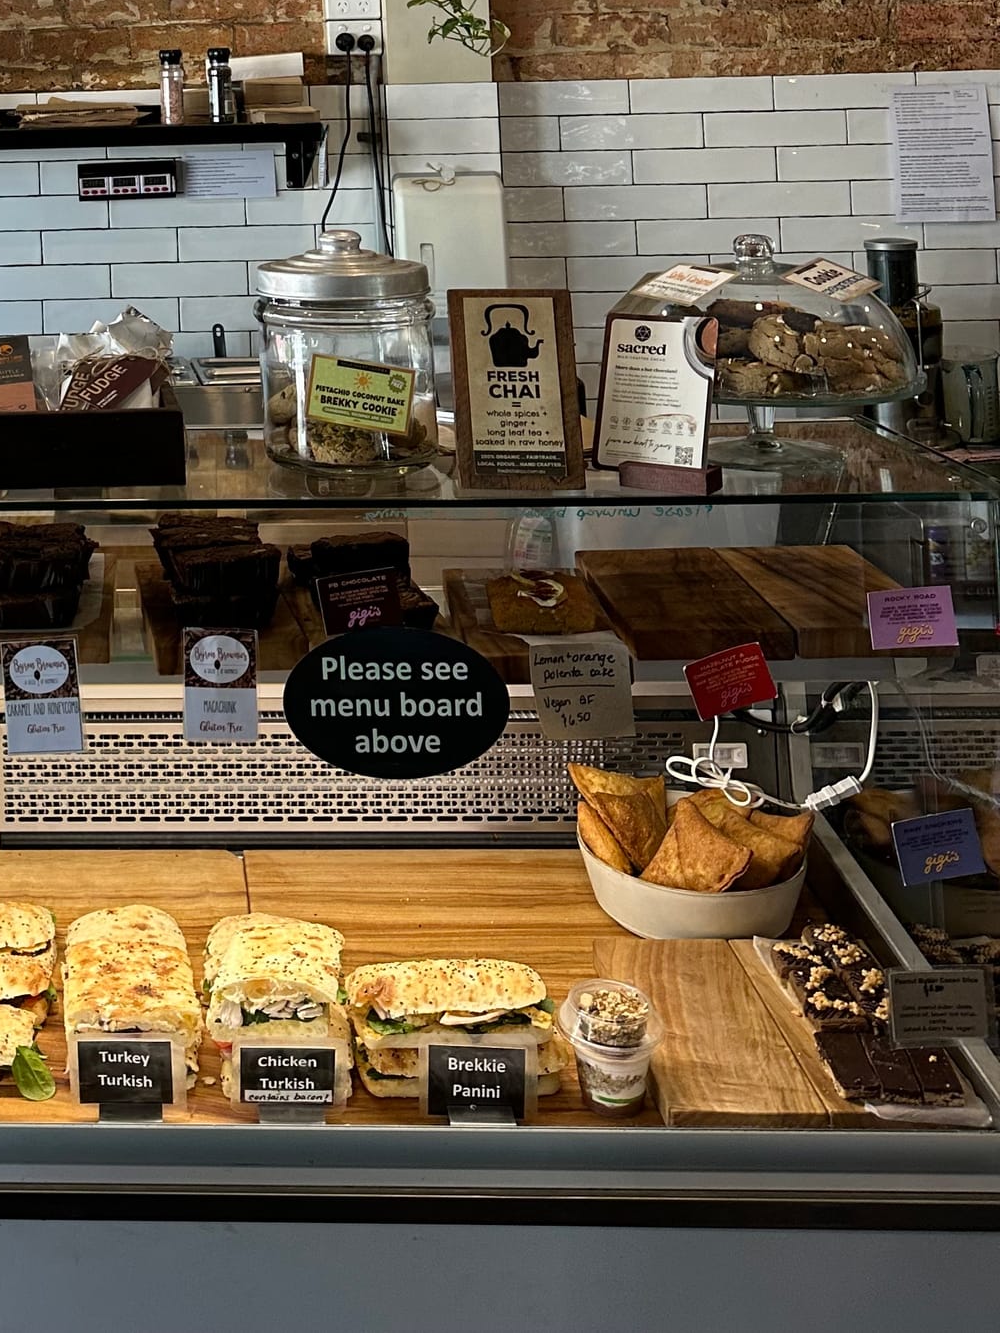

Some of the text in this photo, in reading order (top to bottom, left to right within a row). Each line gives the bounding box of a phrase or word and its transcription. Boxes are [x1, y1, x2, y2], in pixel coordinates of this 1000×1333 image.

[617, 343, 666, 356] sacred
[79, 364, 128, 401] FUDGE
[487, 371, 539, 382] FRESH
[316, 385, 405, 406] PISTACHIO COCONUT BAKE
[489, 385, 540, 399] CHAI
[321, 395, 398, 416] BREKKY COOKIE
[515, 410, 539, 418] spices
[487, 429, 505, 437] long
[539, 439, 563, 447] honey
[322, 656, 468, 680] Please see
[8, 701, 31, 717] CARAMEL
[34, 701, 45, 715] AND
[311, 692, 482, 717] menu board
[355, 728, 441, 754] above
[99, 1052, 150, 1066] Turkey
[258, 1056, 317, 1068] Chicken
[448, 1058, 506, 1072] Brekkie
[98, 1074, 152, 1088] Turkish
[260, 1078, 314, 1090] Turkish
[249, 1092, 330, 1102] contains bacon!
[452, 1084, 500, 1098] Panini
